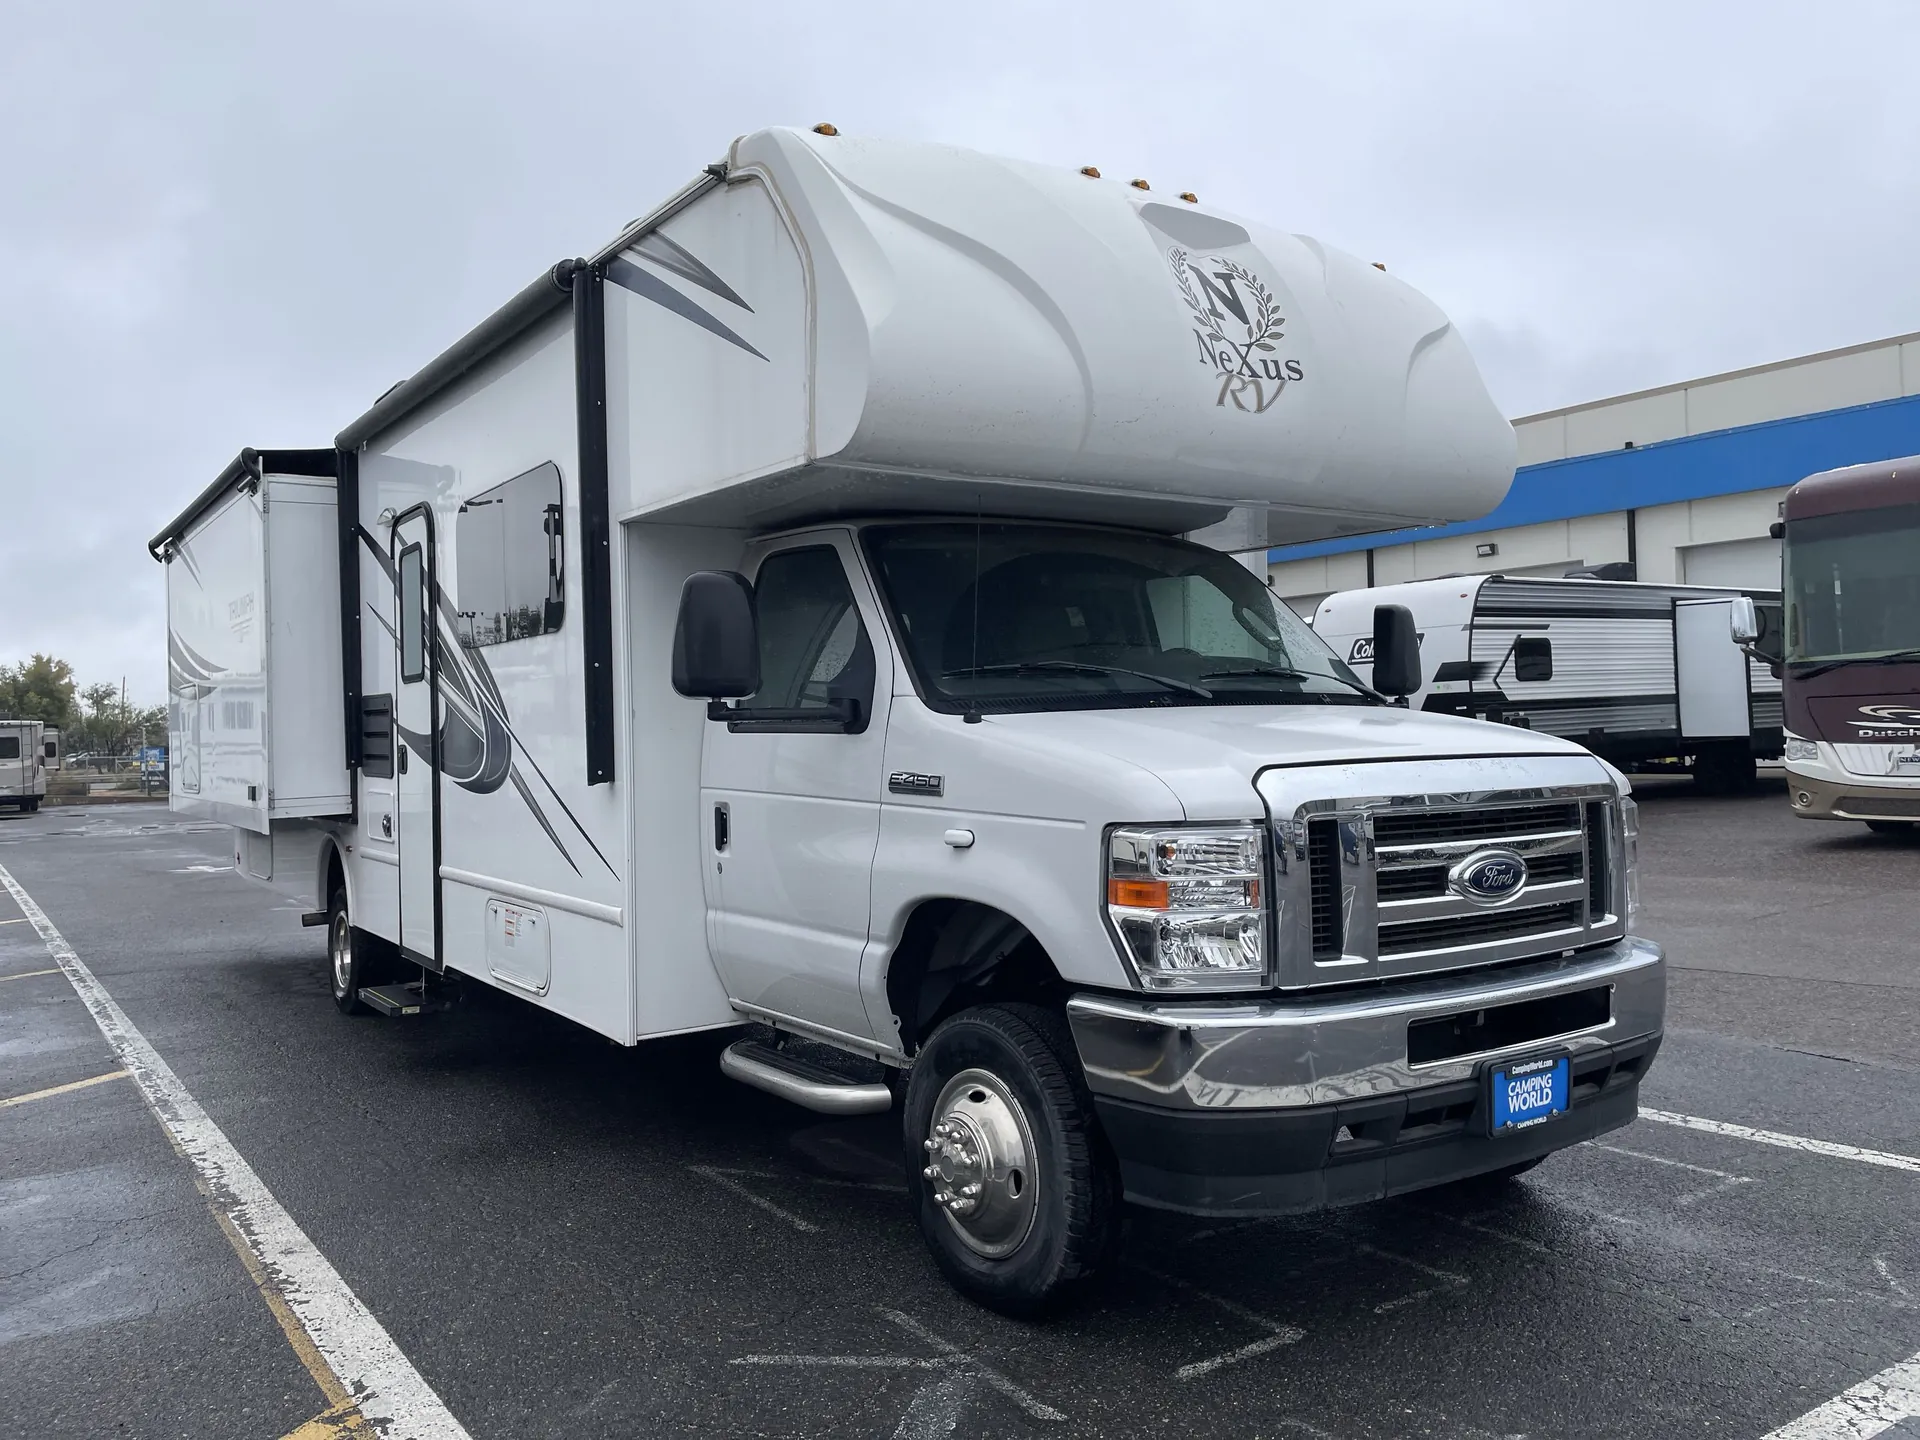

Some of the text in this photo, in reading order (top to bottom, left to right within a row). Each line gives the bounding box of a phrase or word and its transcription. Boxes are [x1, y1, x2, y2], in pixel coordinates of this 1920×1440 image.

[1186, 263, 1251, 325] N
[1215, 371, 1289, 414] RV
[1482, 865, 1515, 888] Ford
[1512, 1059, 1553, 1075] CampingWorld.com
[1508, 1074, 1552, 1096] CAMPING
[1508, 1088, 1552, 1113] WORLD
[1517, 1116, 1547, 1128] CAMPING WORLD
